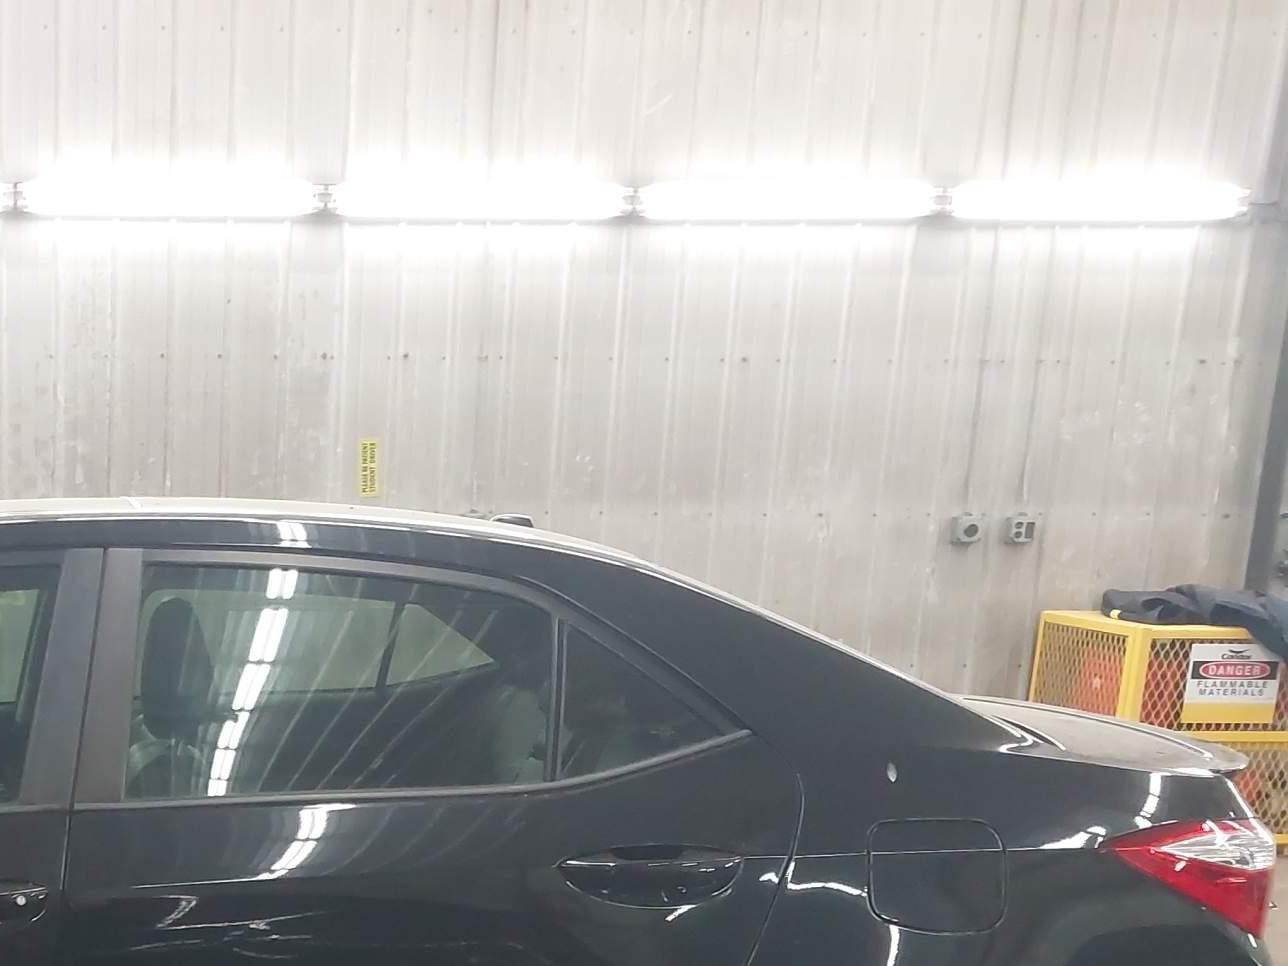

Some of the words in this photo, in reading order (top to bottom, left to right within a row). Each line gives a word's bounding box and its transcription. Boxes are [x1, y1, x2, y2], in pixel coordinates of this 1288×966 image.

[361, 443, 369, 465] PATIENT
[1208, 664, 1262, 676] DANGER
[1198, 688, 1265, 696] MATERIALS
